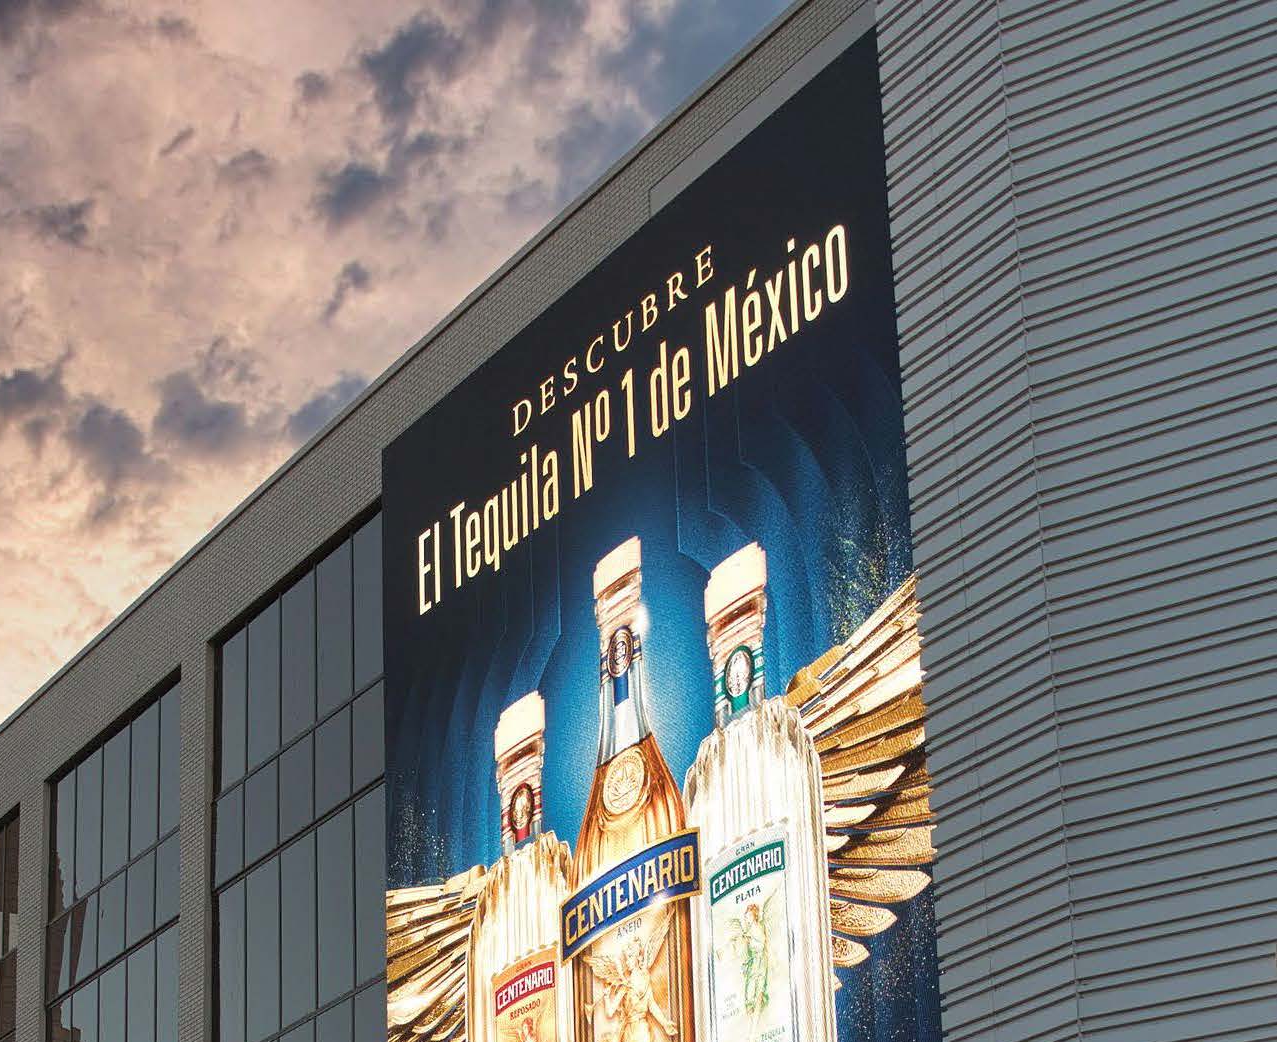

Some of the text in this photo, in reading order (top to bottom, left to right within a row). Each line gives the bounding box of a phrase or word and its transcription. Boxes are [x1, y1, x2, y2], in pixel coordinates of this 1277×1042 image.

[512, 245, 714, 437] DESCUBRE
[417, 521, 441, 616] El
[449, 443, 560, 589] Tequila
[620, 368, 636, 459] 1
[650, 340, 692, 438] de
[703, 224, 850, 397] México
[565, 845, 694, 946] CENTENARIO
[712, 846, 782, 899] CENTENARIO
[735, 885, 761, 904] PLATA
[497, 966, 553, 1010] CENTENARIO
